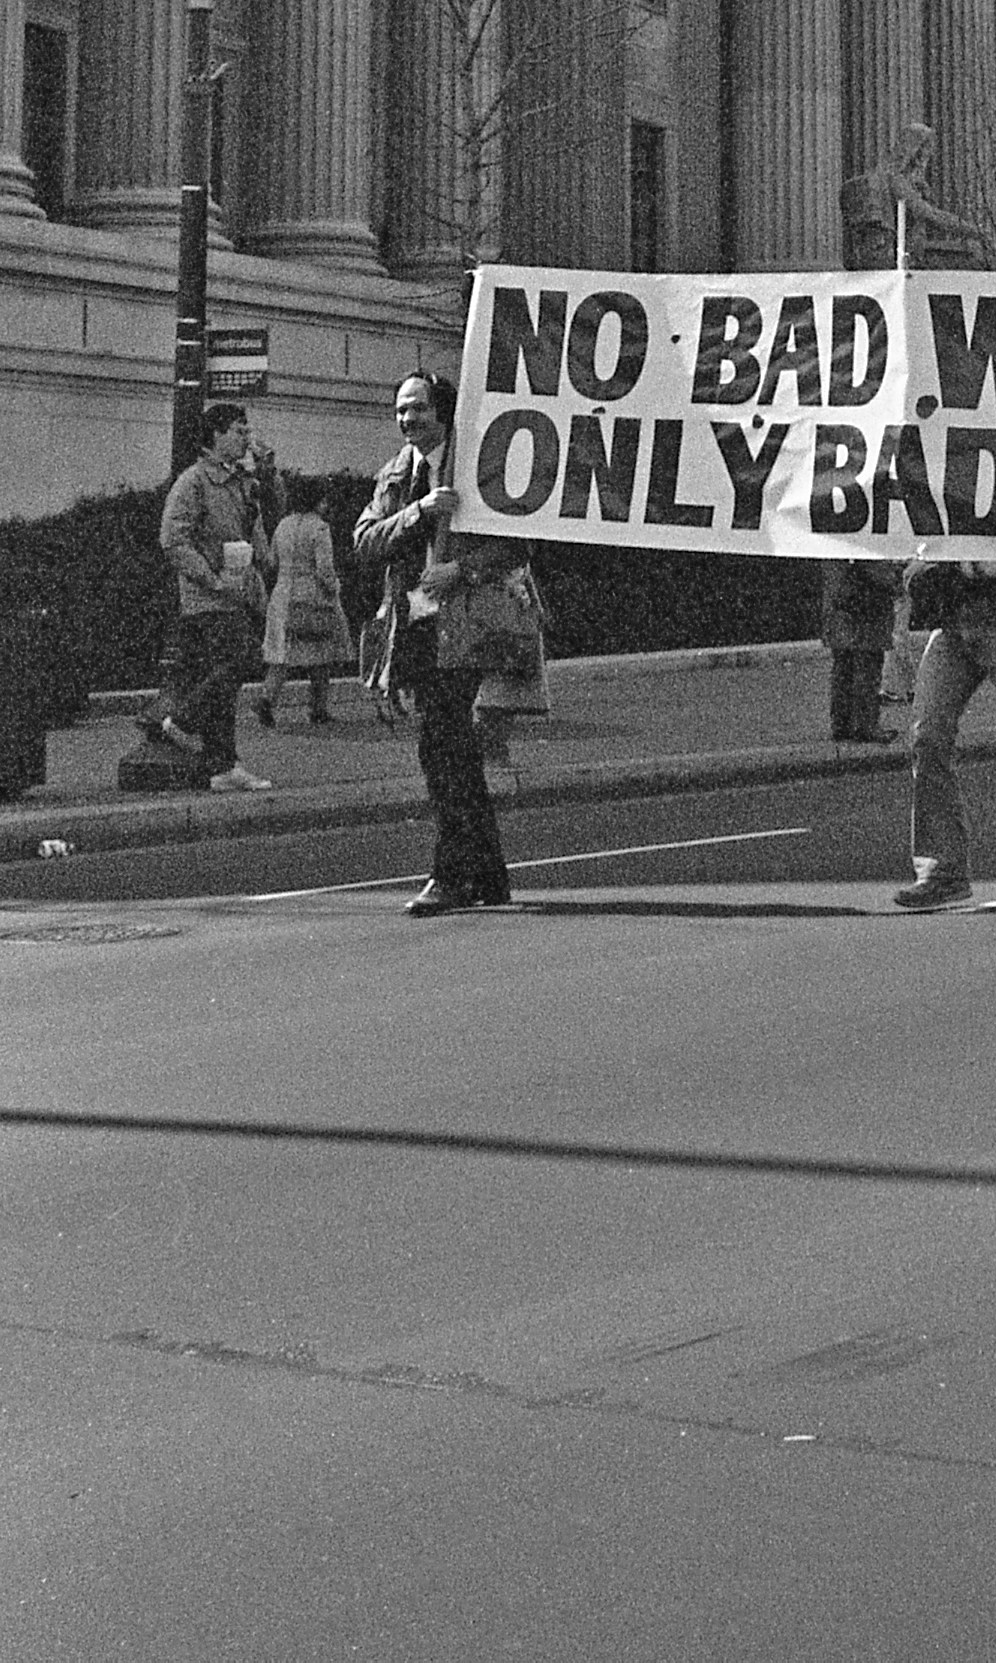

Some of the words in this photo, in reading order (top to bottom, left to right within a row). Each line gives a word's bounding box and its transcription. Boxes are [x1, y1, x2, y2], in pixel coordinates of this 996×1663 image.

[485, 287, 650, 402] NO
[690, 294, 889, 407] BAD
[476, 408, 792, 531] ONLY
